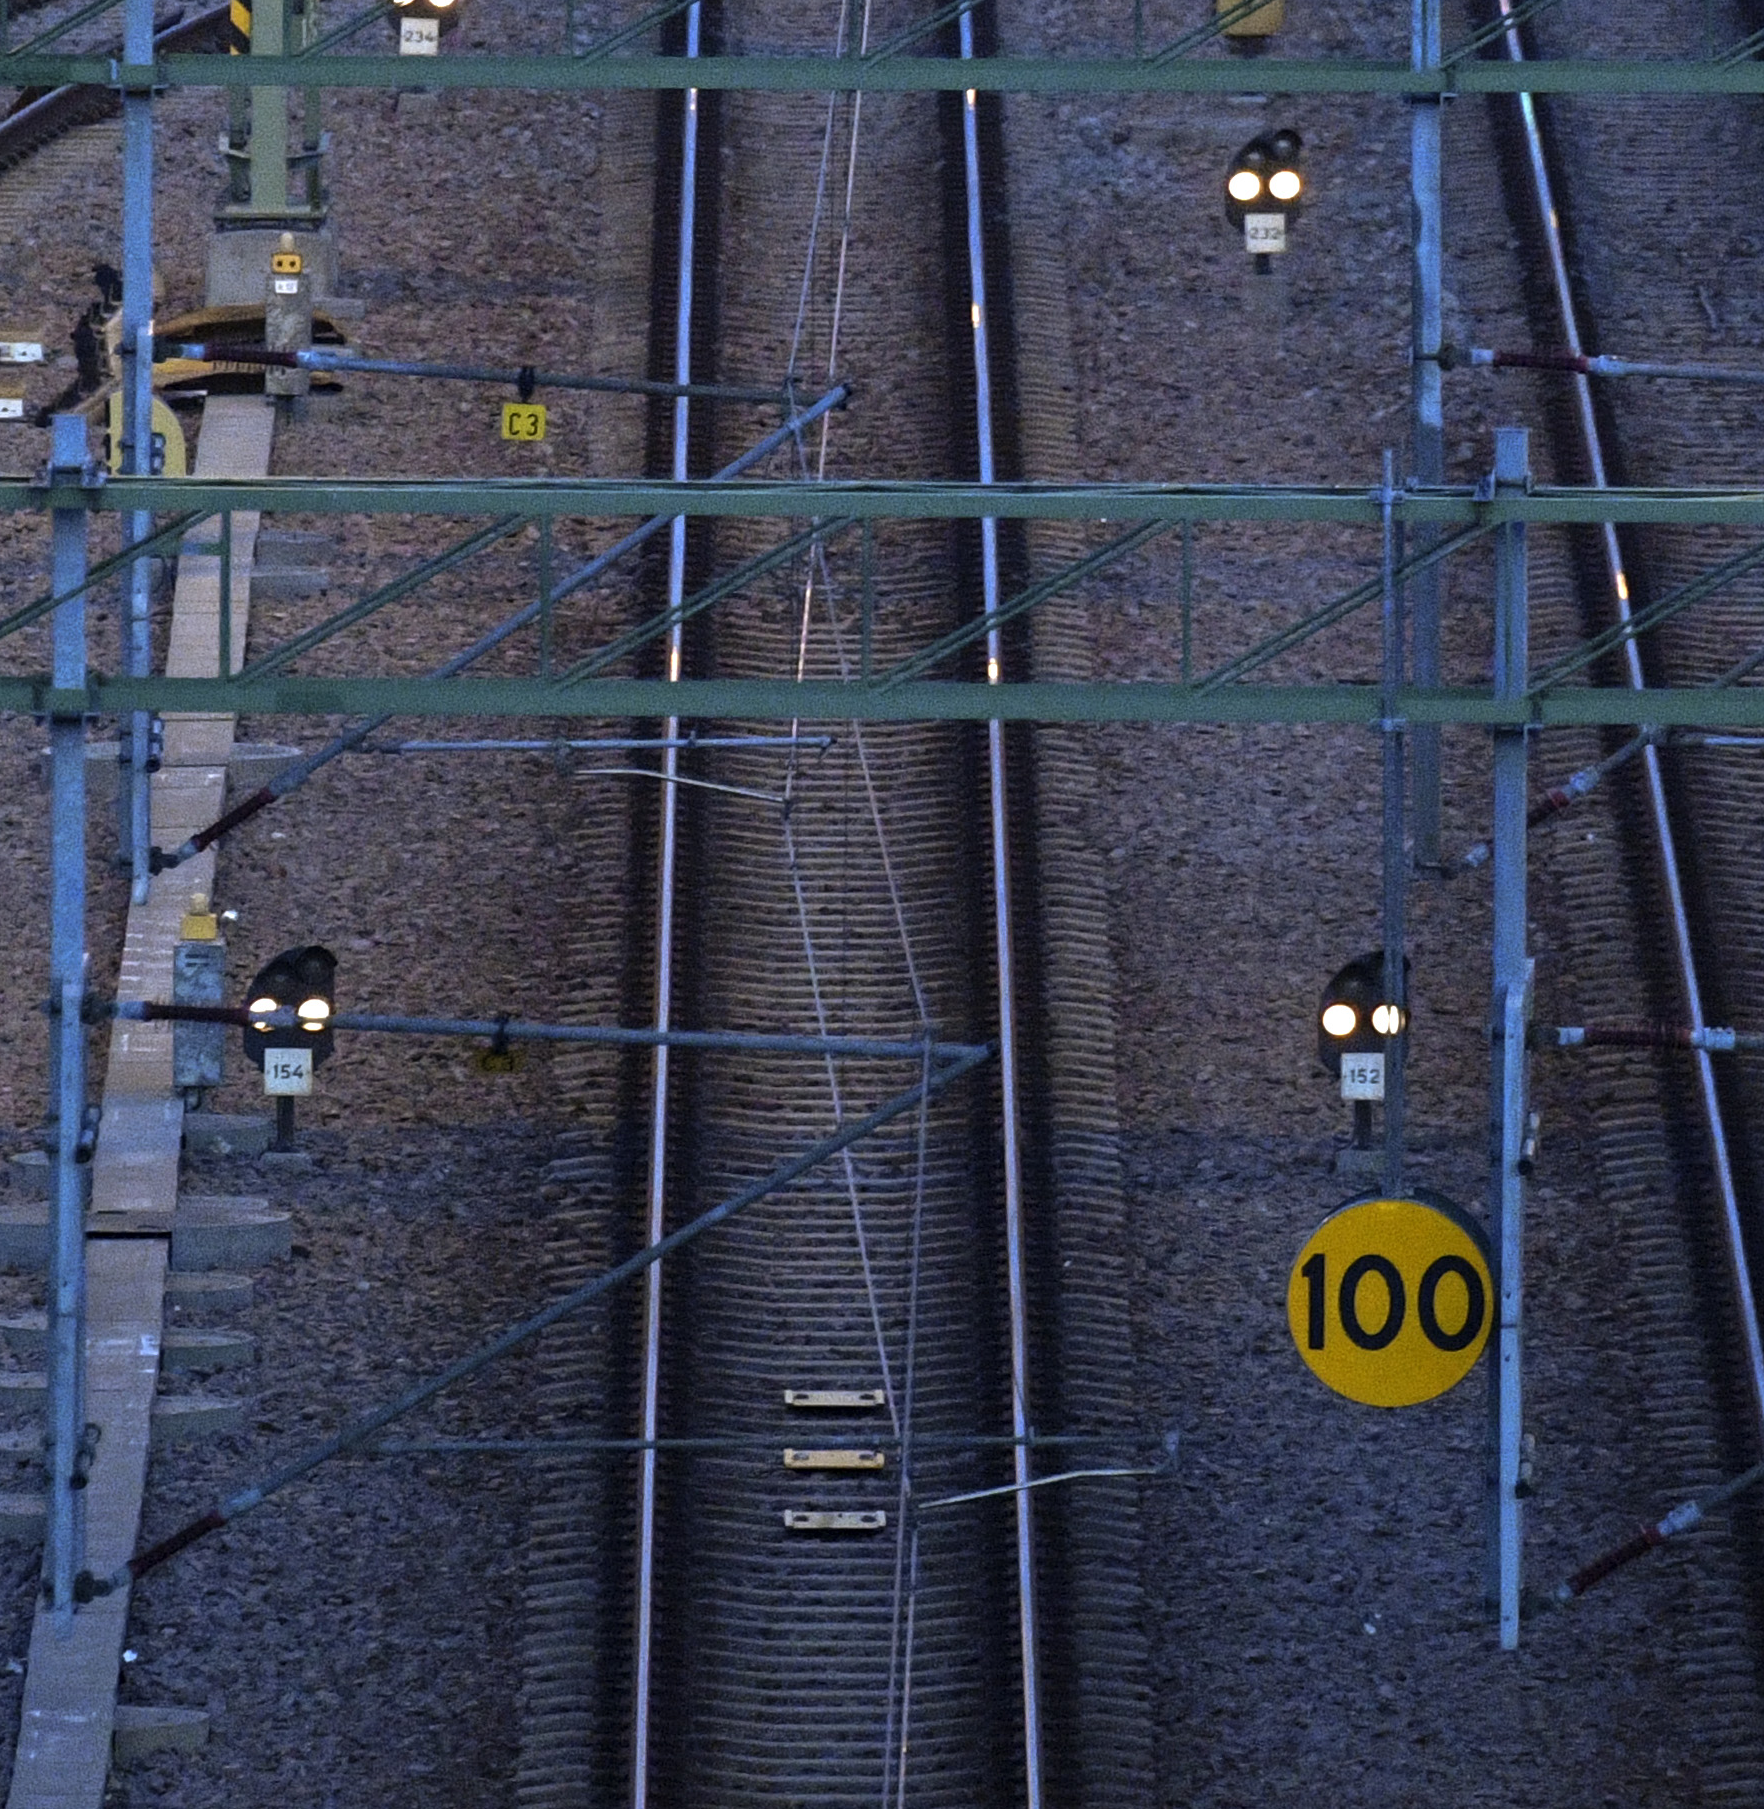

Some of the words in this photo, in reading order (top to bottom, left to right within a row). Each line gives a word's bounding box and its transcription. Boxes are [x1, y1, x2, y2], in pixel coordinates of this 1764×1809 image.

[272, 1064, 304, 1079] 154
[1349, 1068, 1381, 1084] 152
[1301, 1253, 1486, 1352] 100
